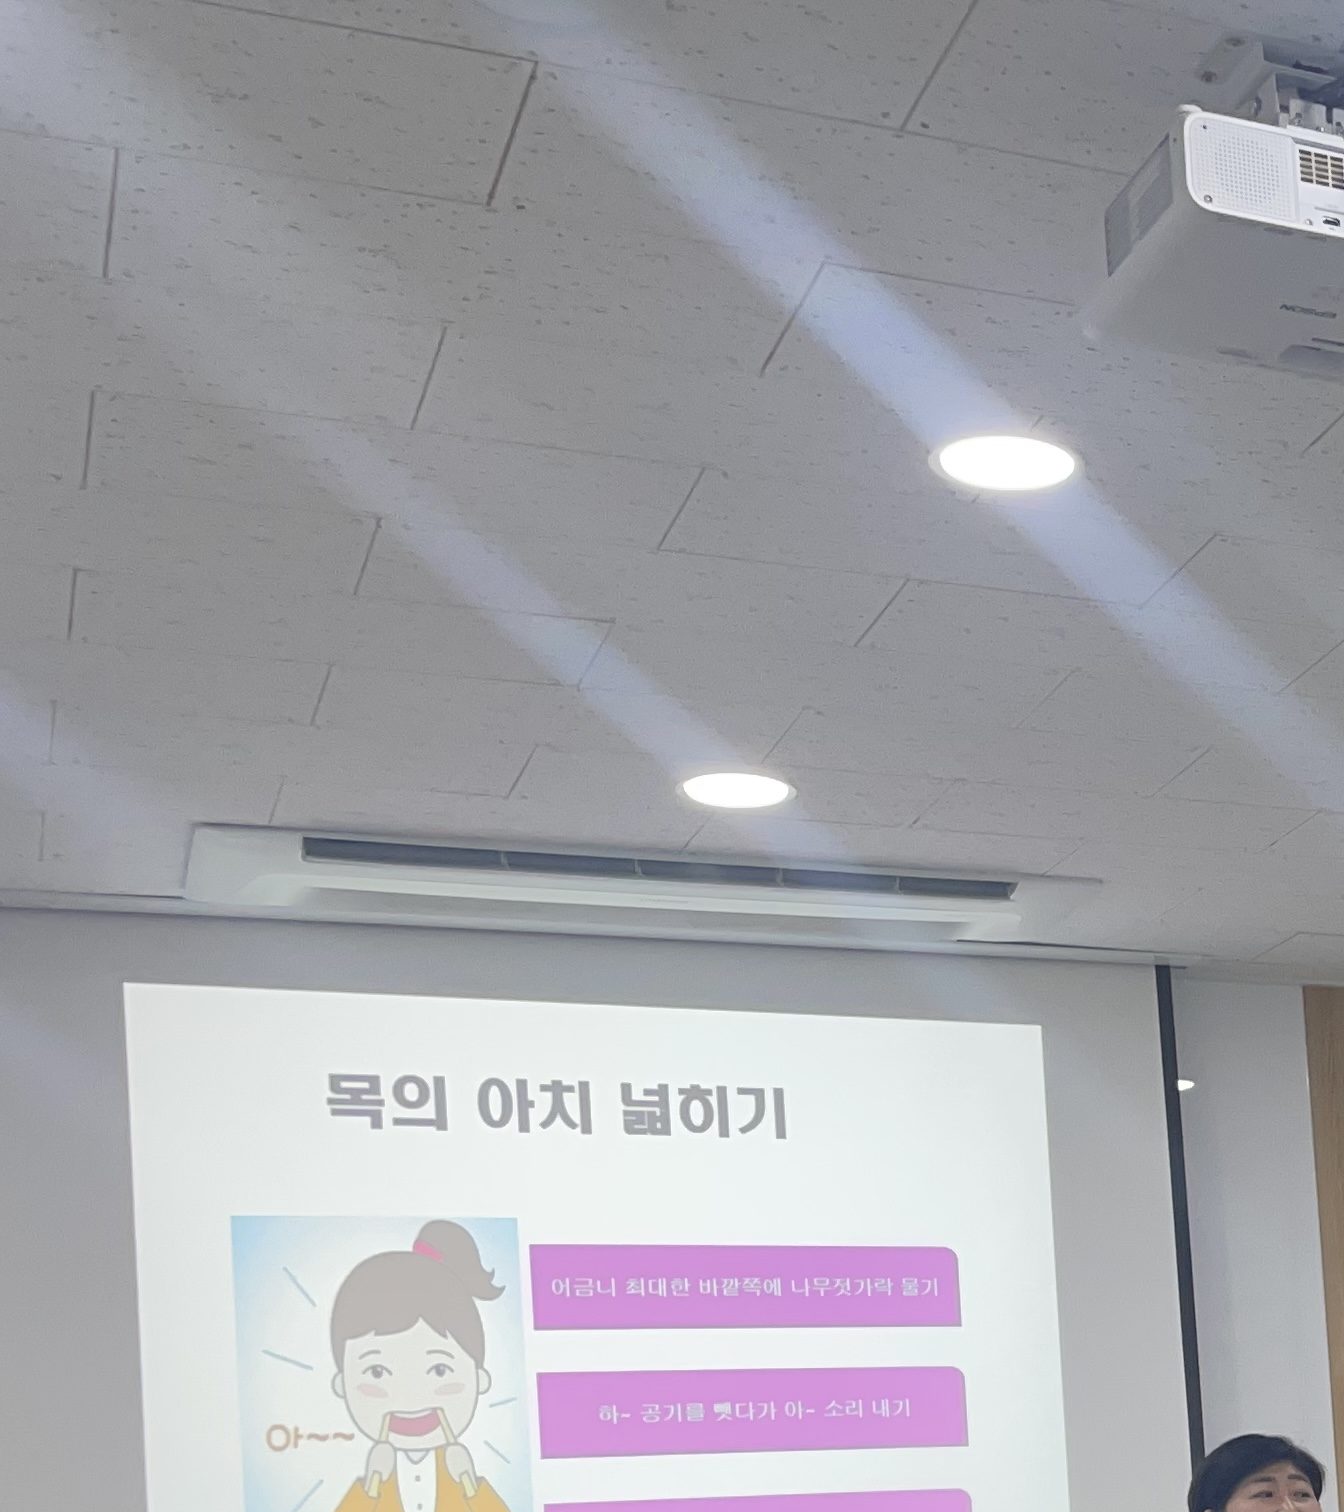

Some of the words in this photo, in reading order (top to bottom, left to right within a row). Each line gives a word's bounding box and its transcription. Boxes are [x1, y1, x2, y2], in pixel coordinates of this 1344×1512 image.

[326, 1073, 449, 1132] 목의
[476, 1077, 593, 1135] 아치
[619, 1082, 788, 1140] 넓히기
[551, 1276, 616, 1298] 어금니
[626, 1276, 692, 1298] 최대한
[699, 1276, 782, 1298] 바깥쪽에
[790, 1276, 894, 1298] 나무젓가락
[900, 1276, 939, 1298] 물기
[640, 1402, 706, 1425] 공기를
[824, 1398, 864, 1420] 소리
[872, 1397, 912, 1418] 내기
